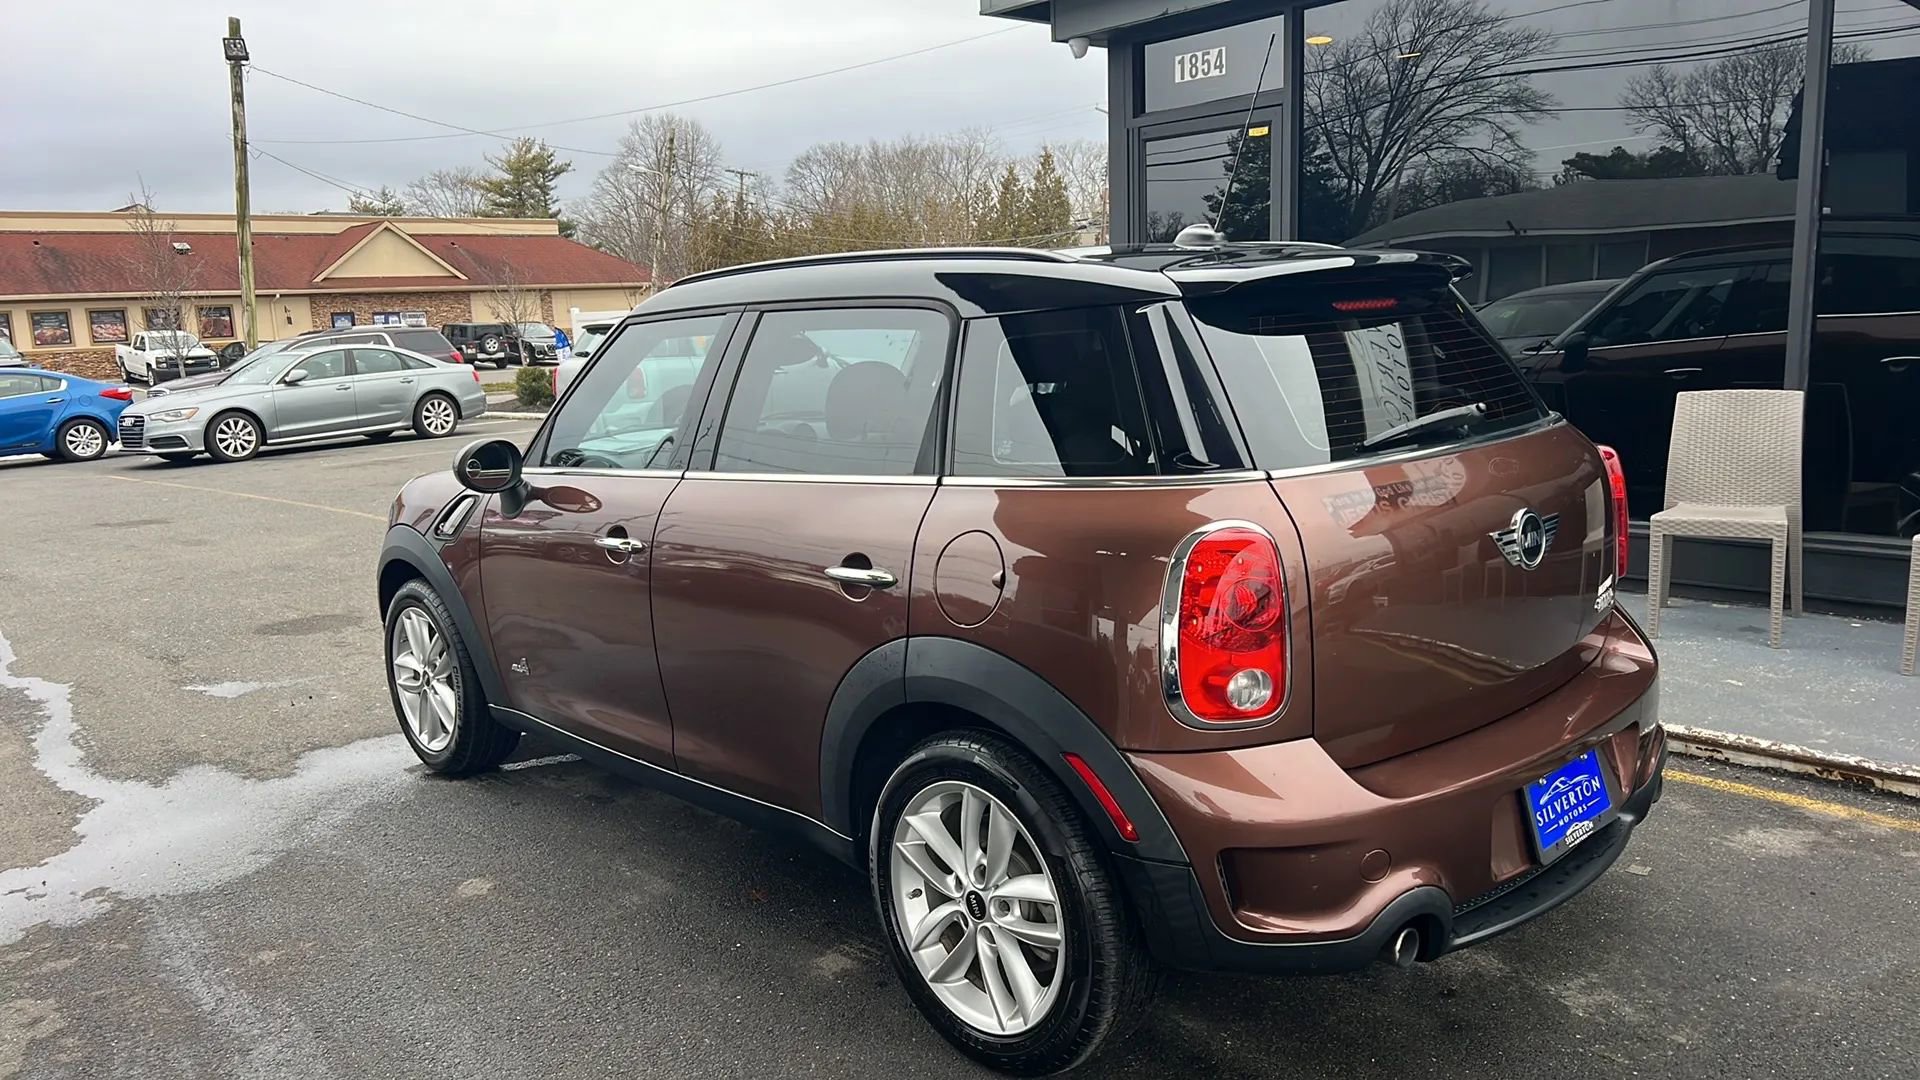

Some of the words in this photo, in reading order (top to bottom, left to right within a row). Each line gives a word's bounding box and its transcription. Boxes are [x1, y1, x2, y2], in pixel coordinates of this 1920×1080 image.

[1177, 48, 1224, 80] 1854
[1536, 776, 1601, 827] SILVERTON
[1559, 806, 1588, 827] MOTORS
[1565, 821, 1594, 845] SILVERTON
[969, 894, 982, 918] MINI
